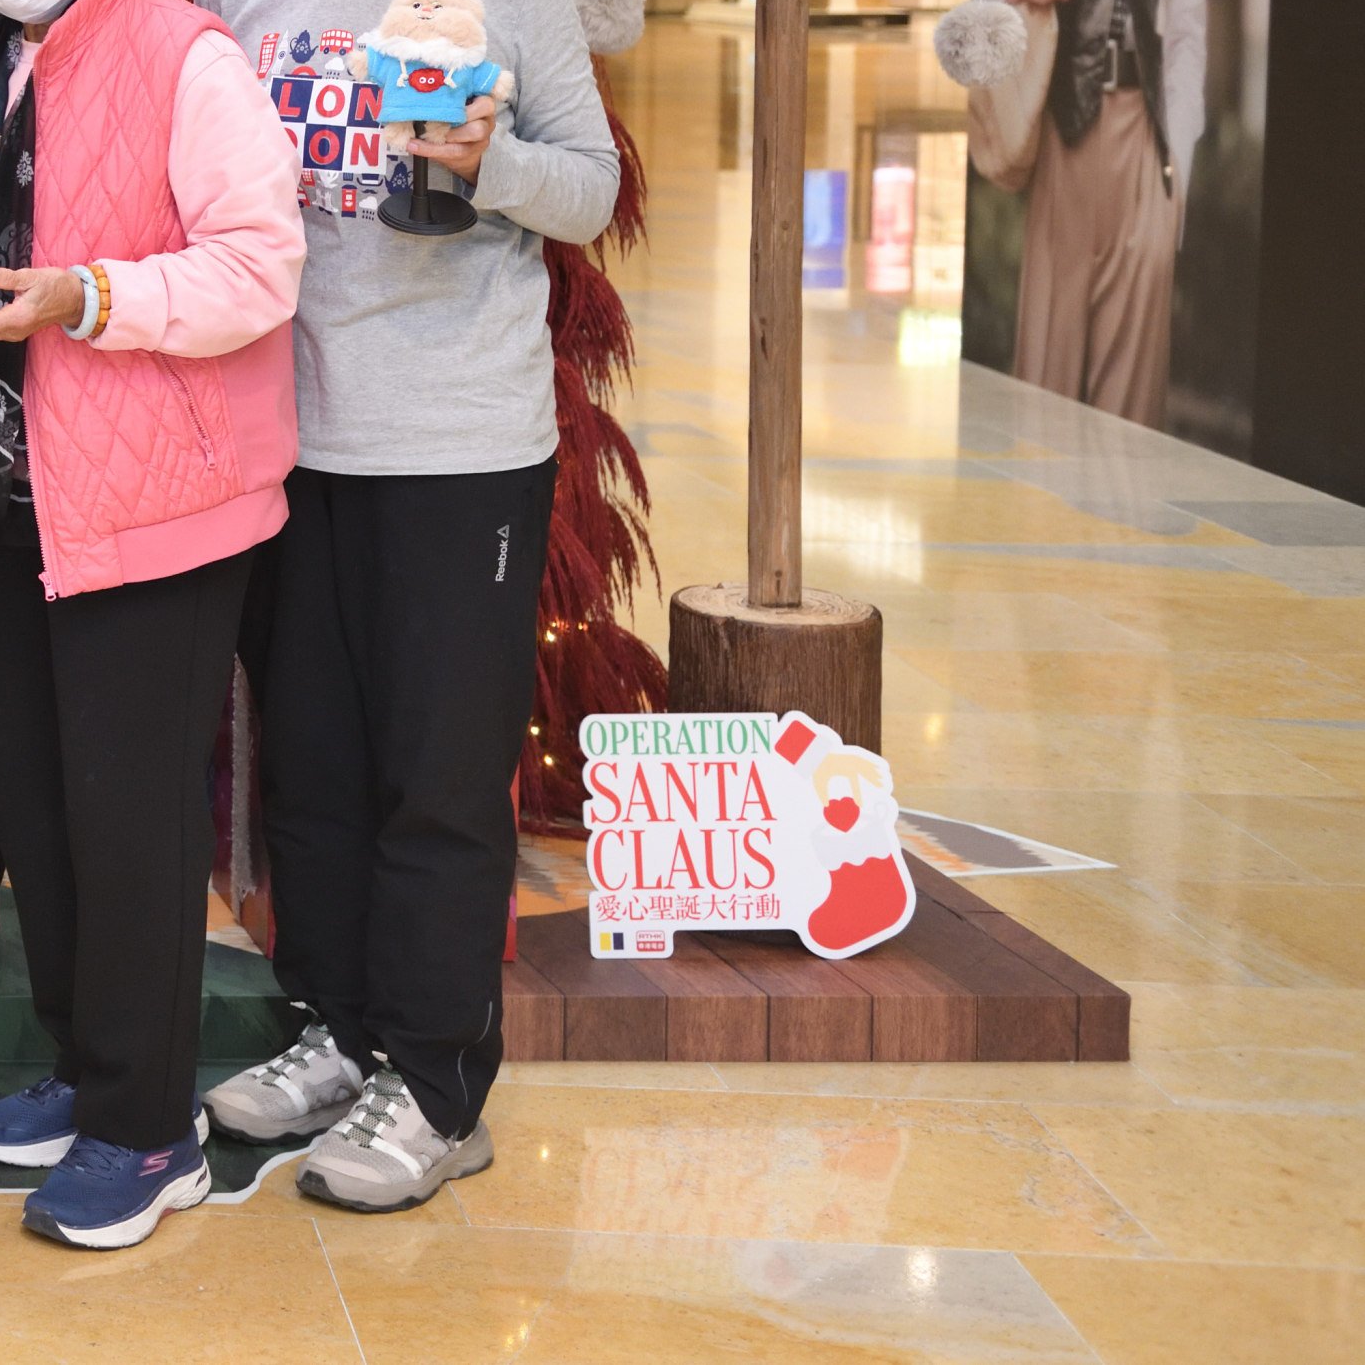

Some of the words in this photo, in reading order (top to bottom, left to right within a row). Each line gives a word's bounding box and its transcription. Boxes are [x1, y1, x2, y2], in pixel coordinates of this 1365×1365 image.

[495, 539, 509, 582] Reebok
[586, 719, 772, 756] OPERATION
[590, 760, 777, 824] SANTA
[592, 827, 776, 891] CLAUS
[596, 893, 781, 922] 愛心聖誕大行動
